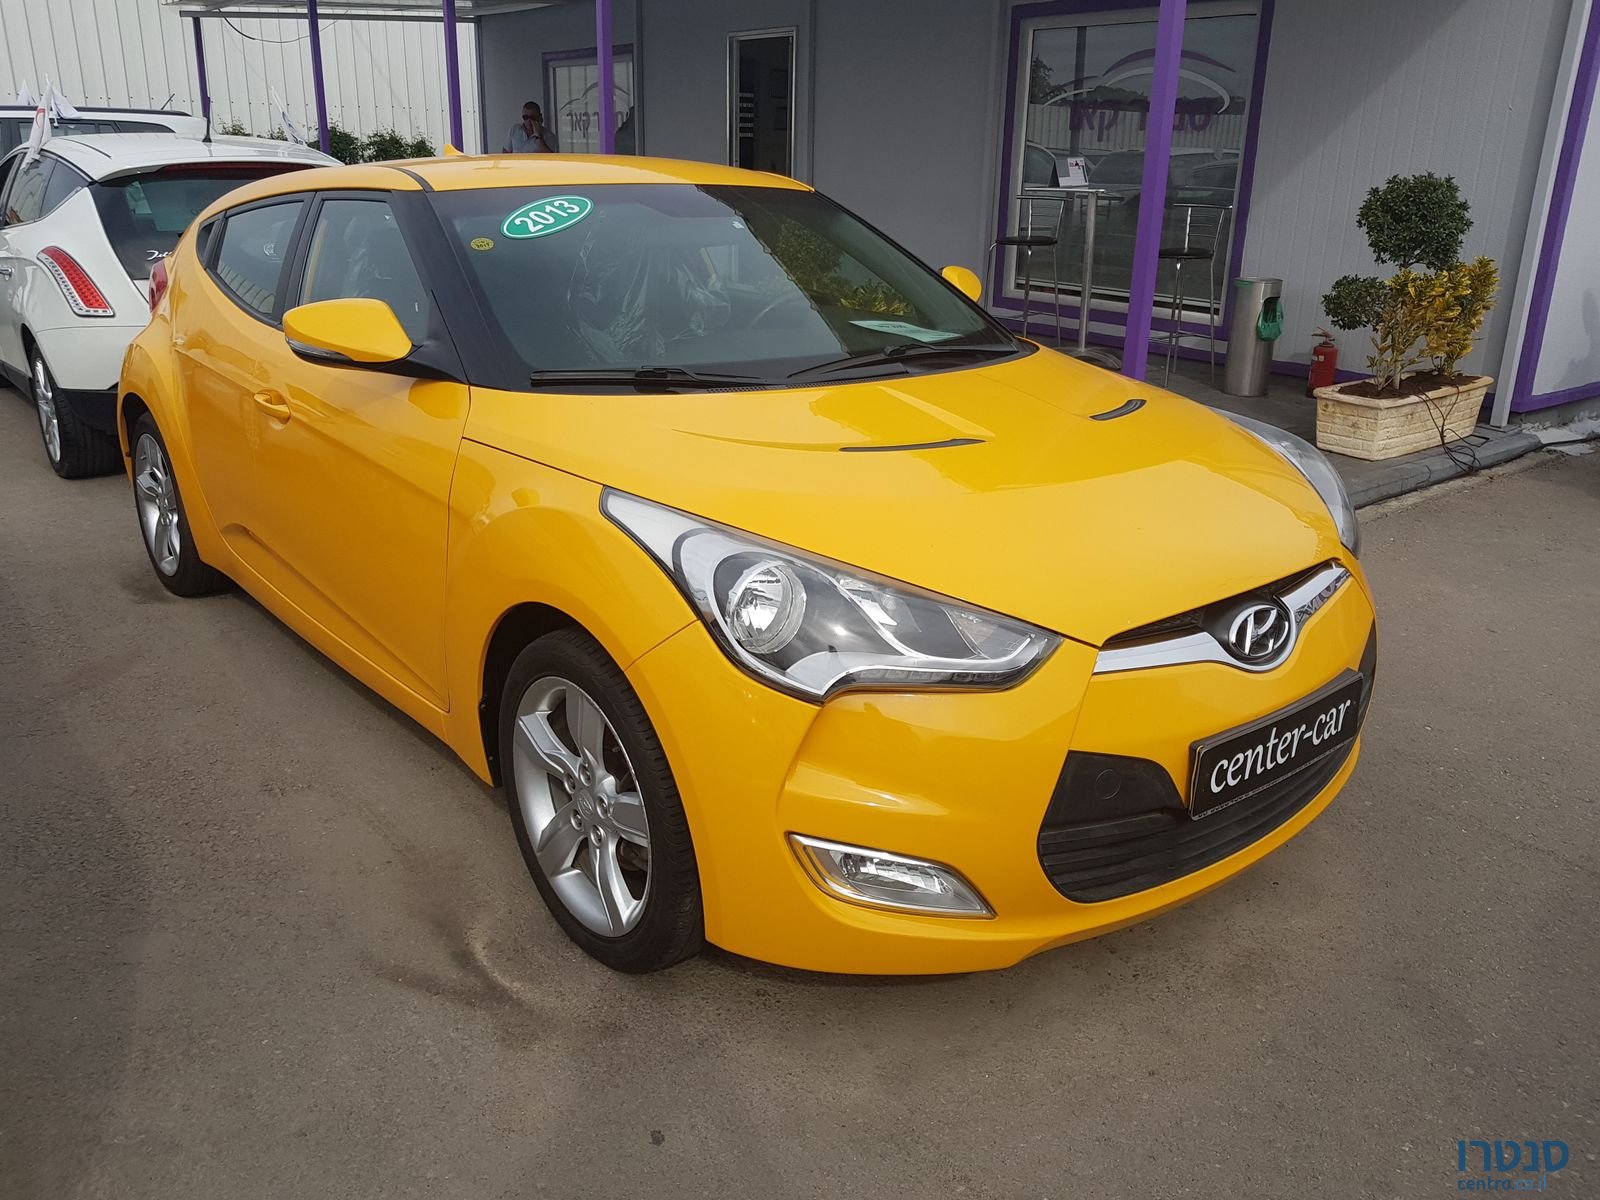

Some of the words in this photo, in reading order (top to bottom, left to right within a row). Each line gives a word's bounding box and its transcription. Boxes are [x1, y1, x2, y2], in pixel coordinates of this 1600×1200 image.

[566, 111, 590, 138] קאר
[514, 200, 580, 233] 2013
[1210, 699, 1351, 794] center-car
